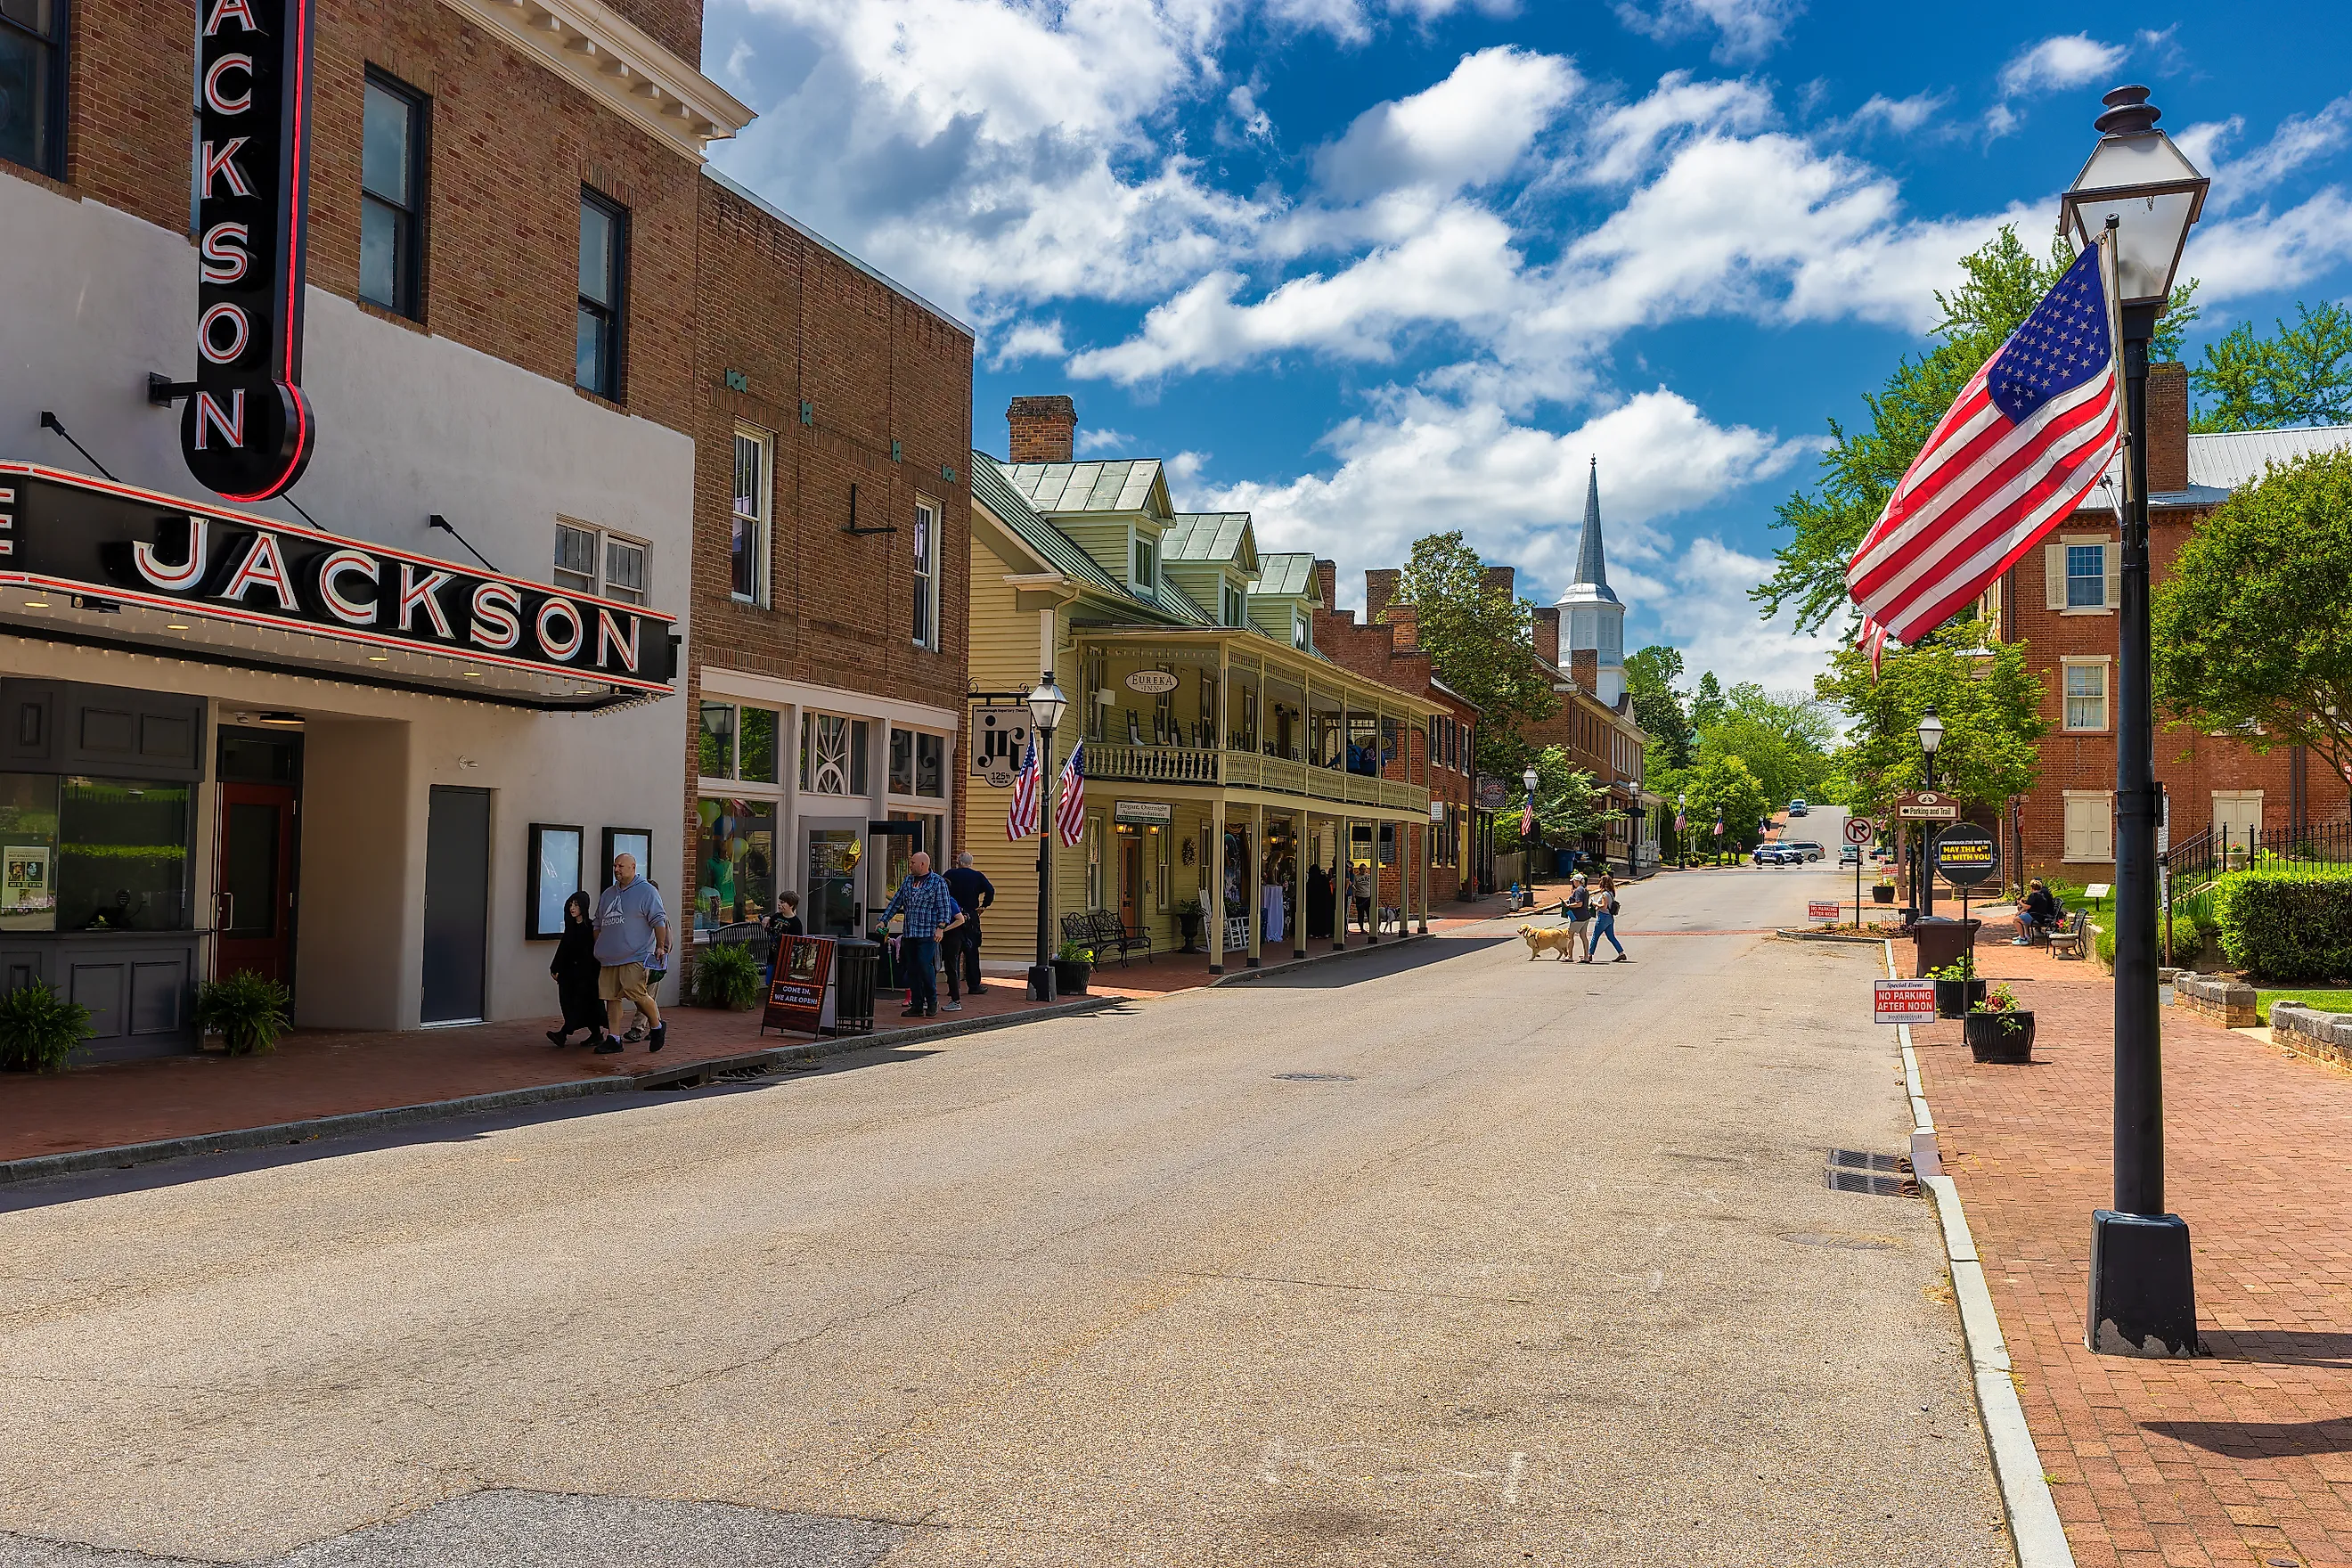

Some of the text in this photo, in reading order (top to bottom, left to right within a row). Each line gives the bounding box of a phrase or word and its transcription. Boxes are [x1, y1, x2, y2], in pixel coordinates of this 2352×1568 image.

[133, 515, 641, 674] JACKSON
[1131, 674, 1173, 686] EUREKA
[1121, 809, 1165, 817] Accommodations
[1909, 807, 1929, 816] Parking
[1940, 807, 1951, 815] Trail
[1940, 853, 1952, 862] BE
[1973, 853, 1991, 861] YOU
[601, 917, 625, 927] Reebok
[782, 985, 801, 994] COME
[774, 993, 785, 1001] WE
[798, 996, 818, 1005] OPEN!
[1878, 991, 1931, 1000] NO PARKING
[1877, 1001, 1932, 1011] AFTER NOON
